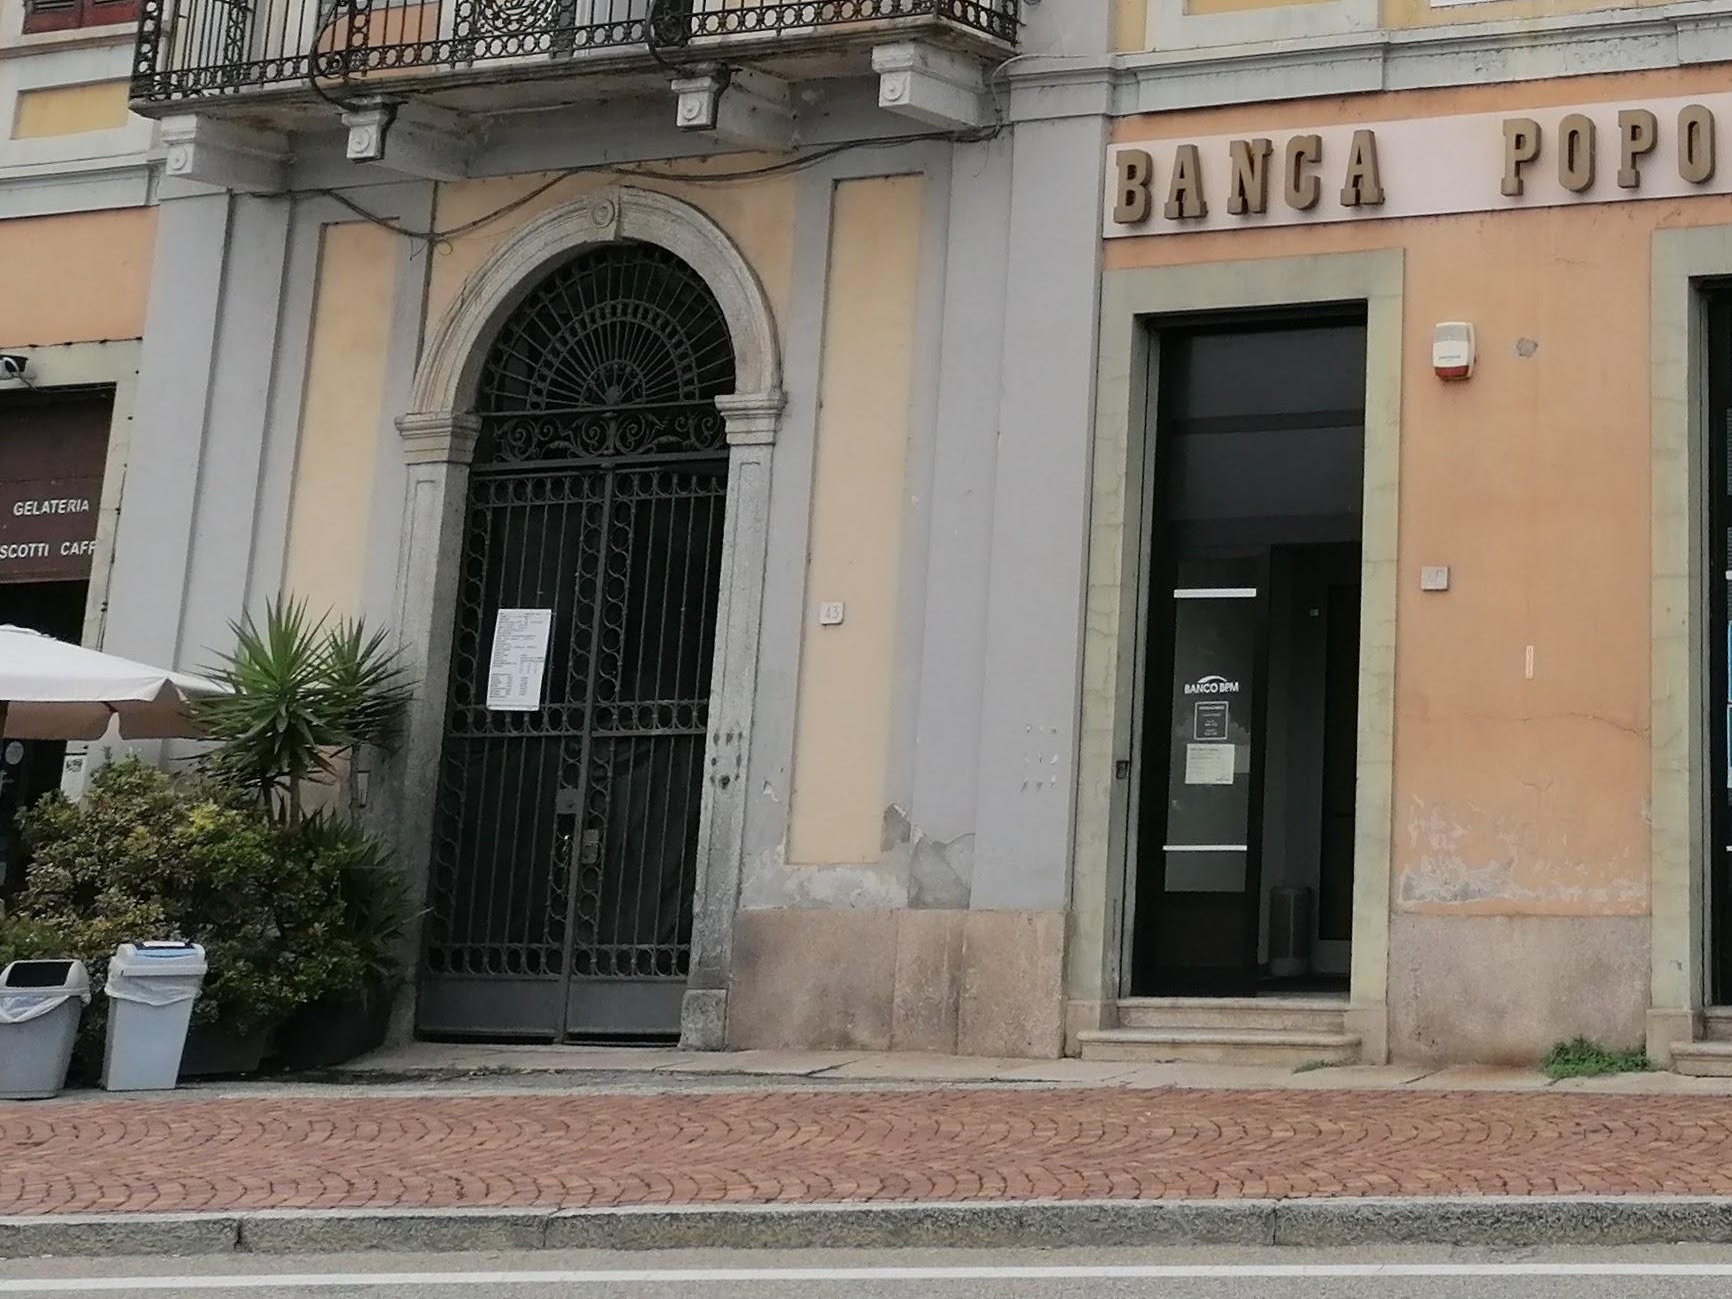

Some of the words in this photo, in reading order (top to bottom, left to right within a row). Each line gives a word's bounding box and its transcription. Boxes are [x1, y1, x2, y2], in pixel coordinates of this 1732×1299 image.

[1113, 129, 1386, 225] BANCA
[13, 498, 90, 517] GELATERIA
[1184, 682, 1219, 694] BANCO
[1219, 682, 1240, 693] BPM
